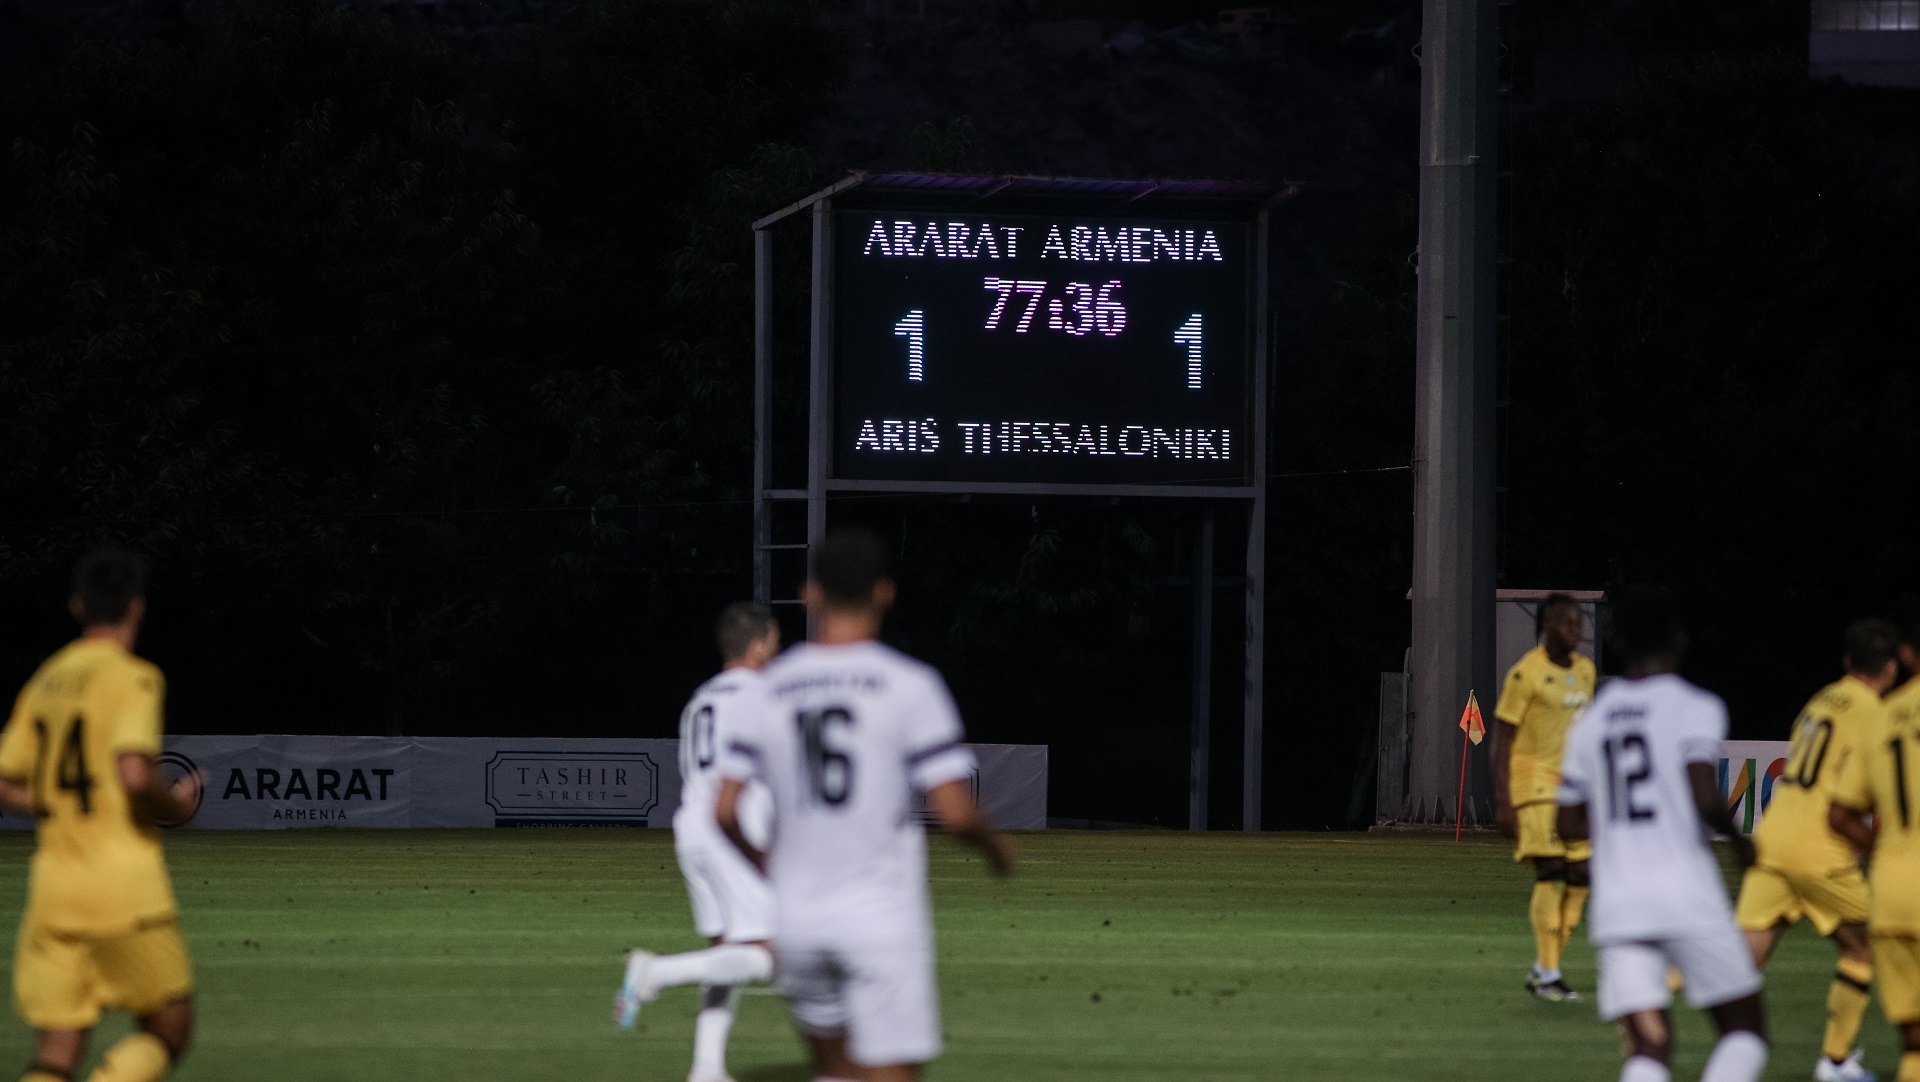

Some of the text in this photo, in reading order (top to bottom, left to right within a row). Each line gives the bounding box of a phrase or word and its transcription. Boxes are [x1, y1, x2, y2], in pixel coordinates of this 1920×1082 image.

[864, 221, 1222, 262] ARARAT ARMENIA
[984, 277, 1126, 336] 77:36
[895, 310, 923, 381] 1
[1174, 314, 1202, 388] 1
[856, 418, 1229, 459] ARIS THESSALONIKI
[797, 706, 853, 804] 16
[223, 768, 394, 800] ARARAT
[516, 767, 627, 786] TASHIR
[537, 790, 607, 801] STREET
[1602, 733, 1656, 820] 12
[273, 809, 347, 820] ARMENIA
